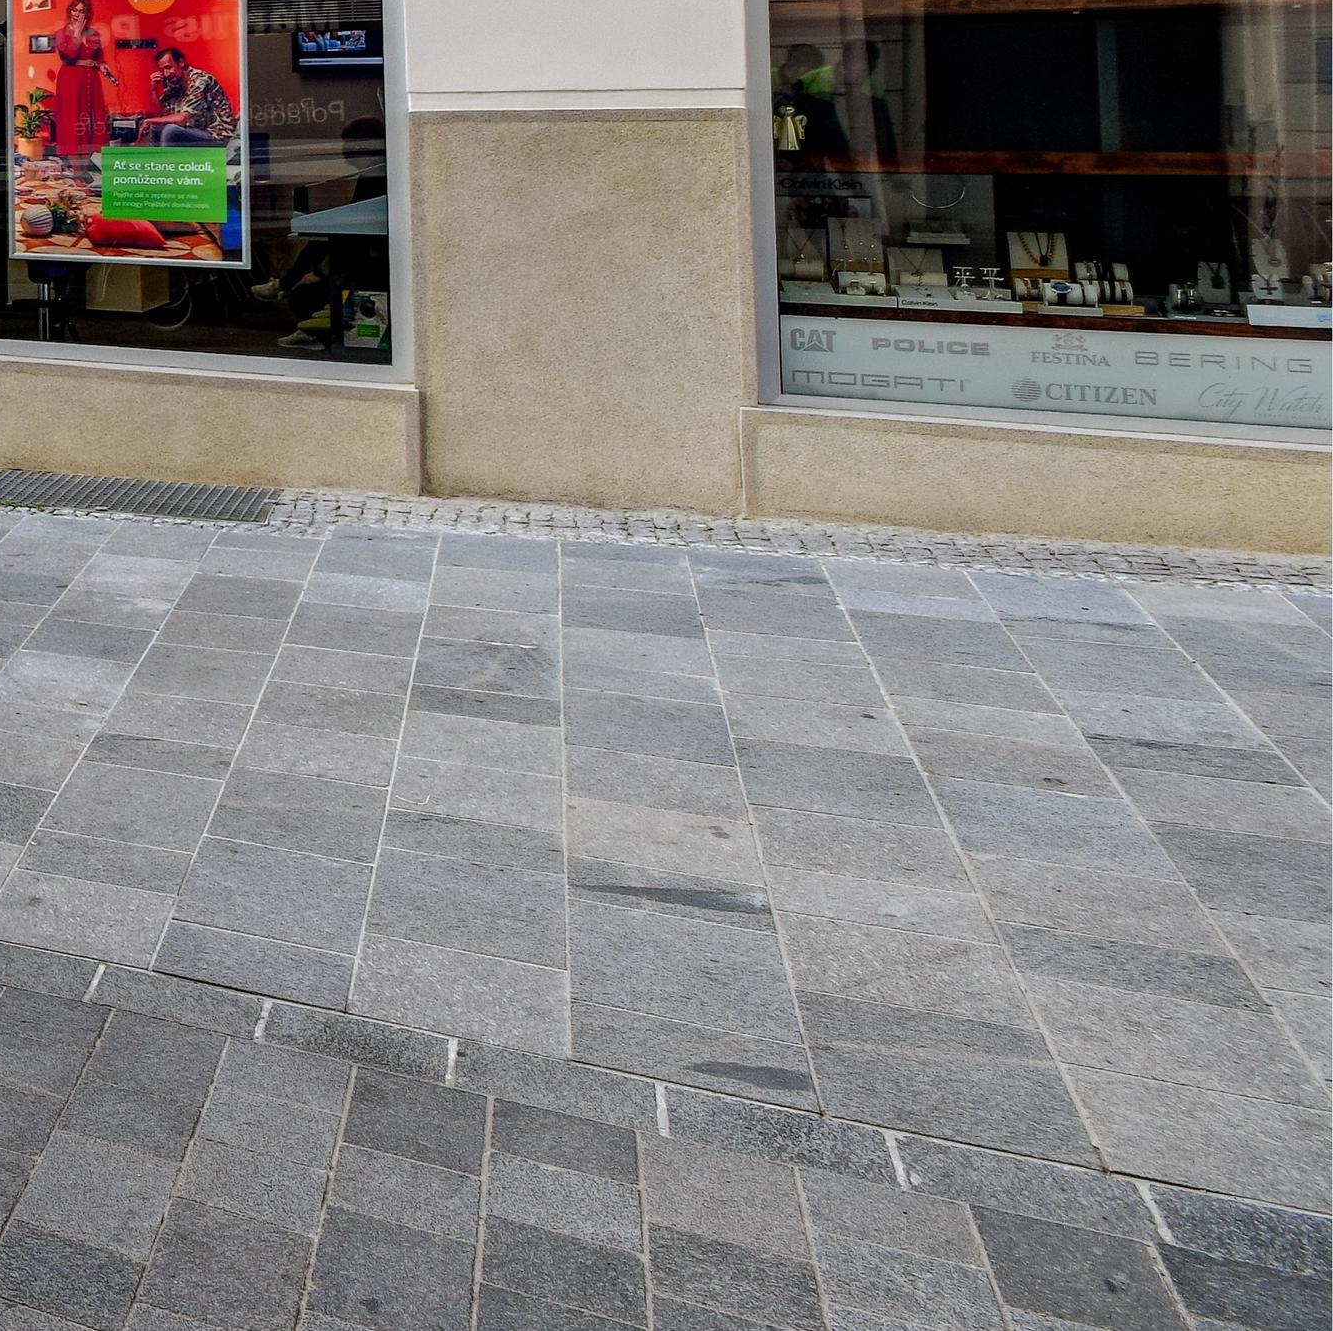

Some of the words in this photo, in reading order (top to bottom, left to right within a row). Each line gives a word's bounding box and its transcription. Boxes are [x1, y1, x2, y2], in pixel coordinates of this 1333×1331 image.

[113, 160, 126, 170] Ať
[128, 162, 142, 171] se
[144, 161, 176, 171] stane
[178, 161, 214, 173] cokoli,
[113, 174, 174, 186] pomůžeme
[176, 176, 203, 186] vám.
[828, 177, 863, 190] Klein
[789, 328, 837, 353] CAT
[871, 337, 990, 356] POLICE
[1030, 351, 1110, 368] FESTINA
[1134, 351, 1312, 374] BERING
[1045, 383, 1157, 406] CITIZEN
[1198, 382, 1246, 414] City
[1254, 385, 1327, 414] Watch
